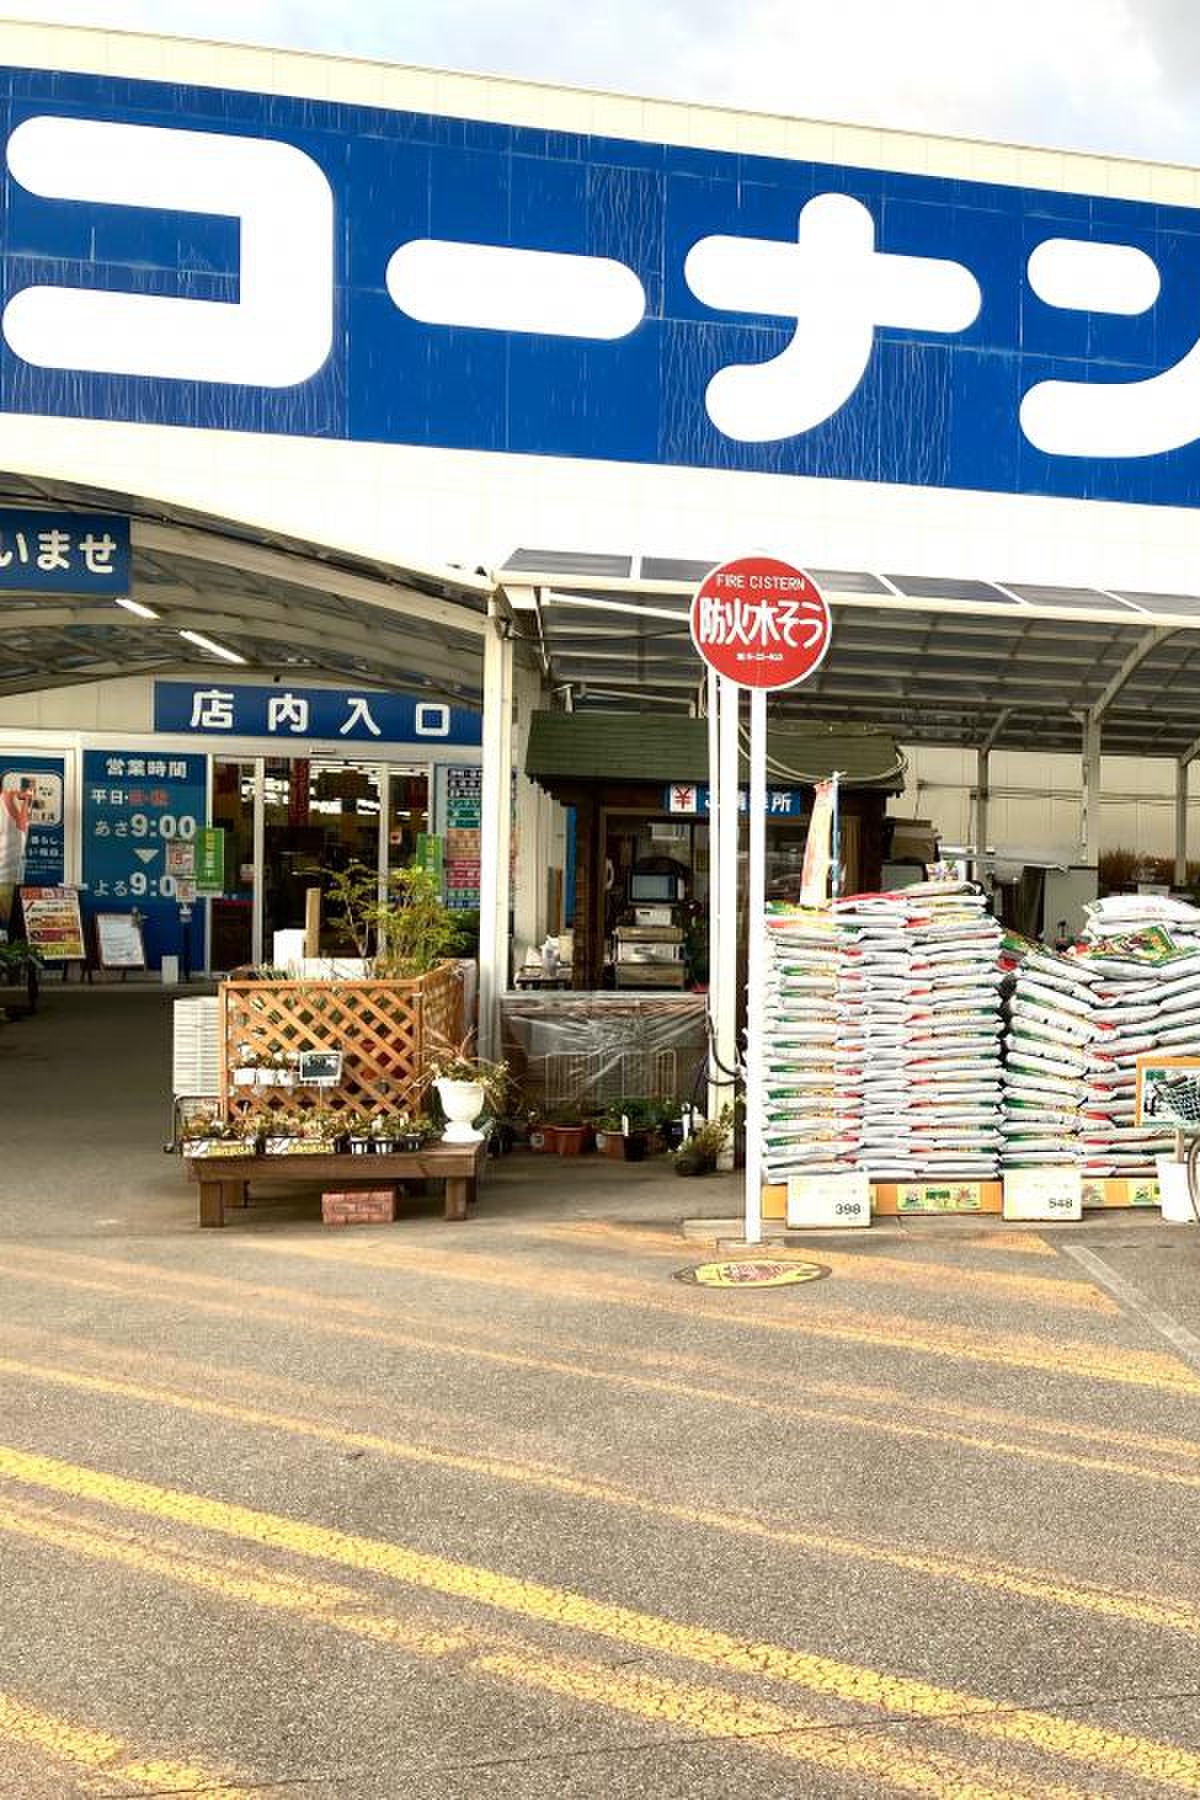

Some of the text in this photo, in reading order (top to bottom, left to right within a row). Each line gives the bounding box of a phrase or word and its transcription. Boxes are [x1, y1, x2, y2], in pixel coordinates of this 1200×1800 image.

[717, 573, 805, 591] FIRE CISTERN
[700, 598, 823, 649] 防火水そう
[190, 689, 451, 737] 店内入口
[105, 758, 187, 779] 営業時間
[835, 1203, 861, 1216] 398
